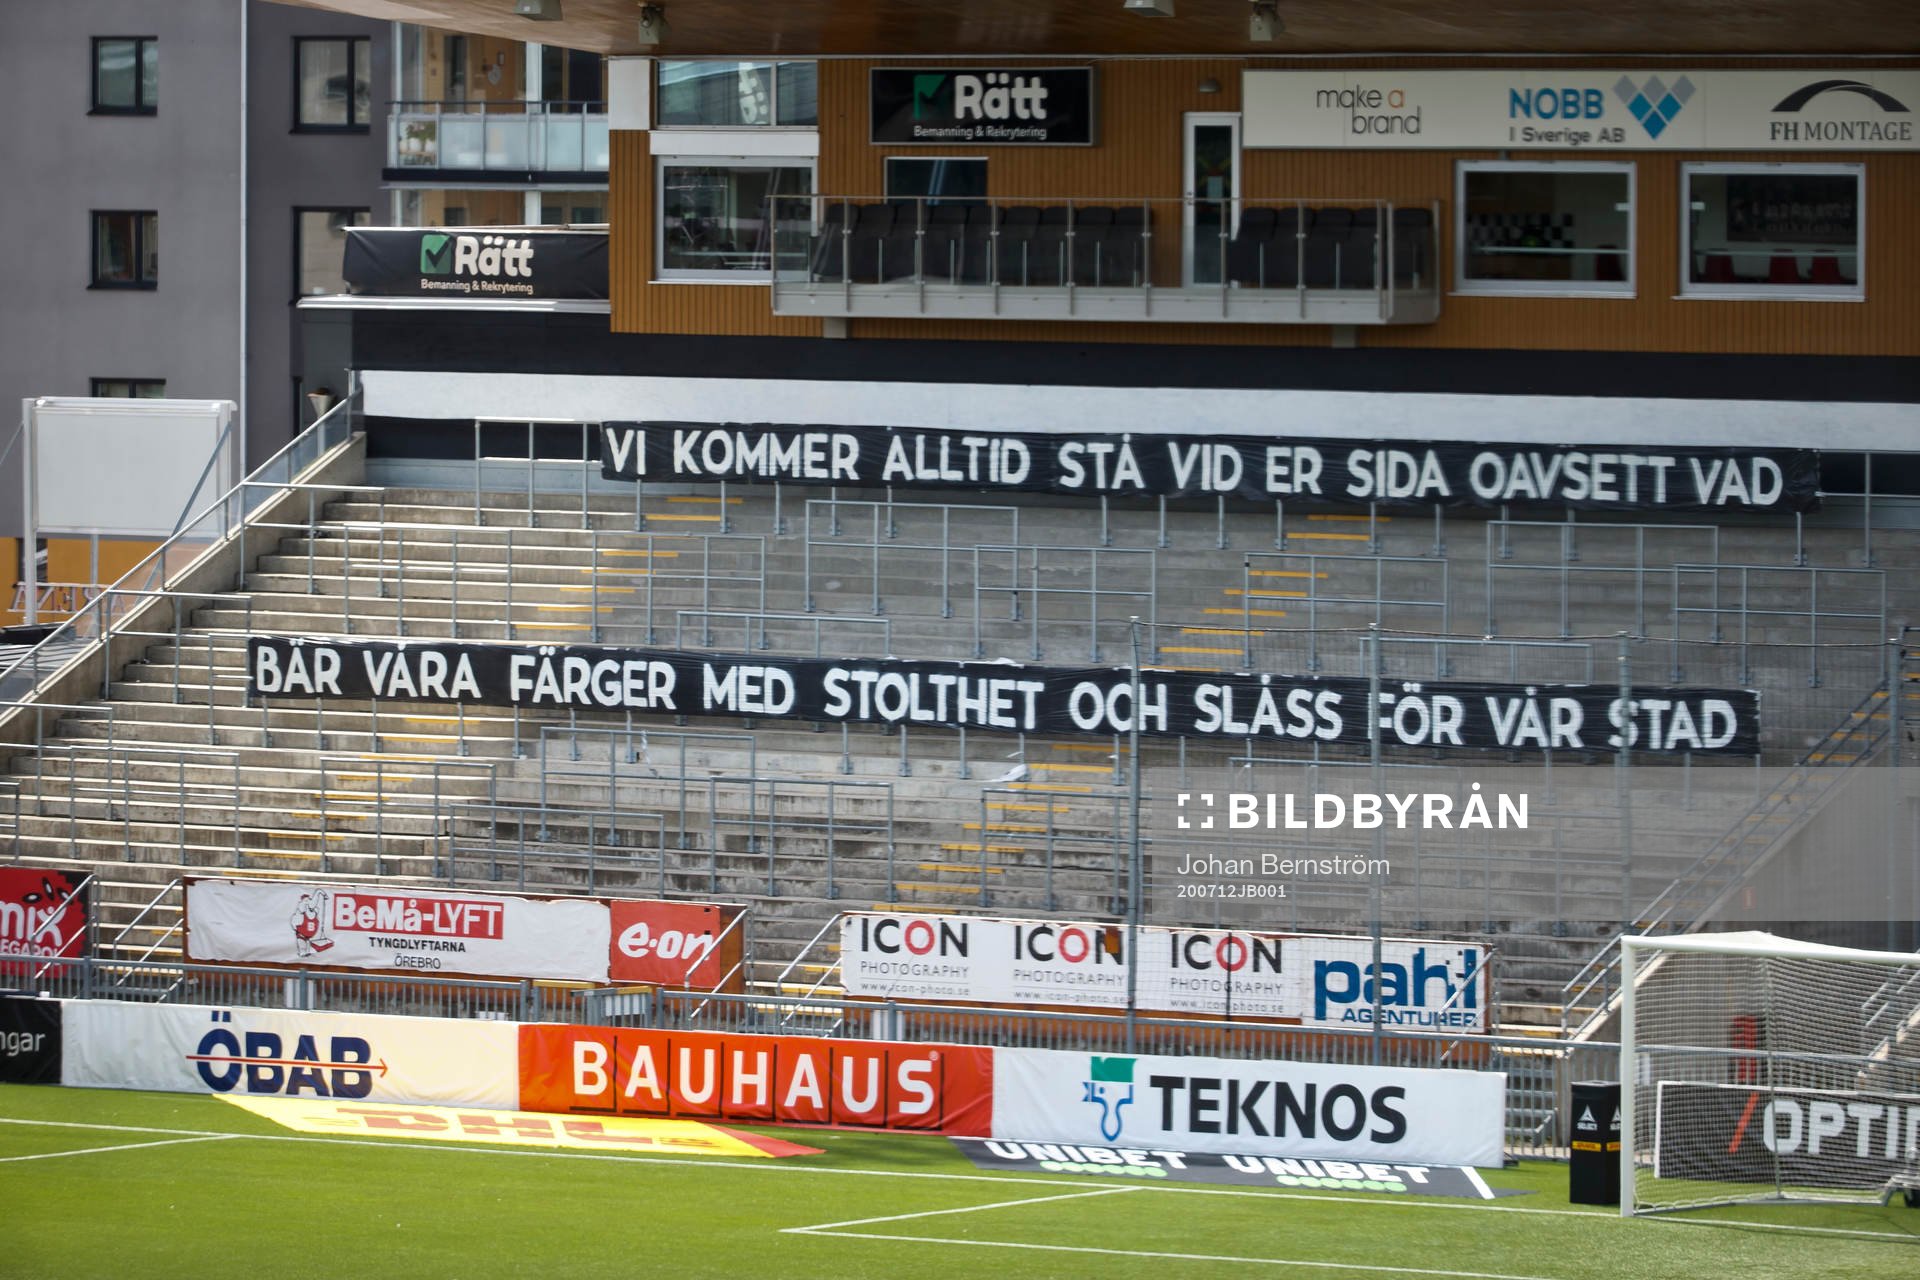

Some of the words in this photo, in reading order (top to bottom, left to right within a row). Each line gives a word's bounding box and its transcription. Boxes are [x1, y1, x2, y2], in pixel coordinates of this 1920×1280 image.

[955, 72, 1048, 120] Rätt
[1316, 84, 1382, 108] make
[1388, 89, 1404, 108] a
[1509, 87, 1605, 119] NOBB
[913, 125, 974, 140] Bemanning
[974, 126, 984, 137] &
[986, 126, 1047, 140] Rekrytering
[1352, 105, 1421, 135] brand
[1770, 121, 1800, 141] FH
[1804, 121, 1913, 141] MONTAGE
[1522, 126, 1591, 146] Sverige
[1598, 127, 1626, 143] AB
[455, 235, 534, 277] Rätt
[420, 278, 470, 293] Bemanning
[472, 280, 480, 291] &
[481, 280, 534, 295] Rekrytering
[606, 427, 646, 475] VI
[673, 430, 860, 480] KOMMER
[882, 434, 1031, 484] ALLTID
[1058, 433, 1145, 489] STÅ
[1168, 442, 1243, 492] VID
[1266, 447, 1323, 495] ER
[1346, 449, 1451, 498] SIDA
[1469, 452, 1676, 503] OAVSETT
[1690, 457, 1784, 505] VAD
[256, 640, 343, 695] BÄR
[362, 643, 482, 698] VÅRA
[510, 646, 678, 710] FÄRGER
[703, 663, 795, 714] MED
[823, 667, 1045, 730] STOLTHET
[1068, 681, 1168, 732] OCH
[1193, 673, 1344, 740] SLÅSS
[1367, 681, 1465, 745] FÖR
[1485, 686, 1585, 748] VÅR
[1607, 697, 1738, 749] STAD
[335, 896, 502, 937] BeMå-LYFT
[369, 936, 467, 953] TYNGDLYFTARNA
[861, 917, 969, 958] ICON
[1015, 925, 1124, 966] ICON
[394, 953, 441, 970] ÖREBRO
[1171, 933, 1283, 974] ICON
[860, 961, 970, 978] PHOTOGRAPHY
[1013, 968, 1125, 987] PHOTOGRAPHY
[1313, 947, 1478, 1021] pahl
[1170, 977, 1283, 995] PHOTOGRAPHY
[196, 1010, 373, 1099] ÖBAB
[573, 1041, 935, 1115] BAUHAUS
[1149, 1075, 1408, 1144] TEKNOS
[984, 1140, 1188, 1170] UNIBET
[1222, 1154, 1430, 1184] UNIBET
